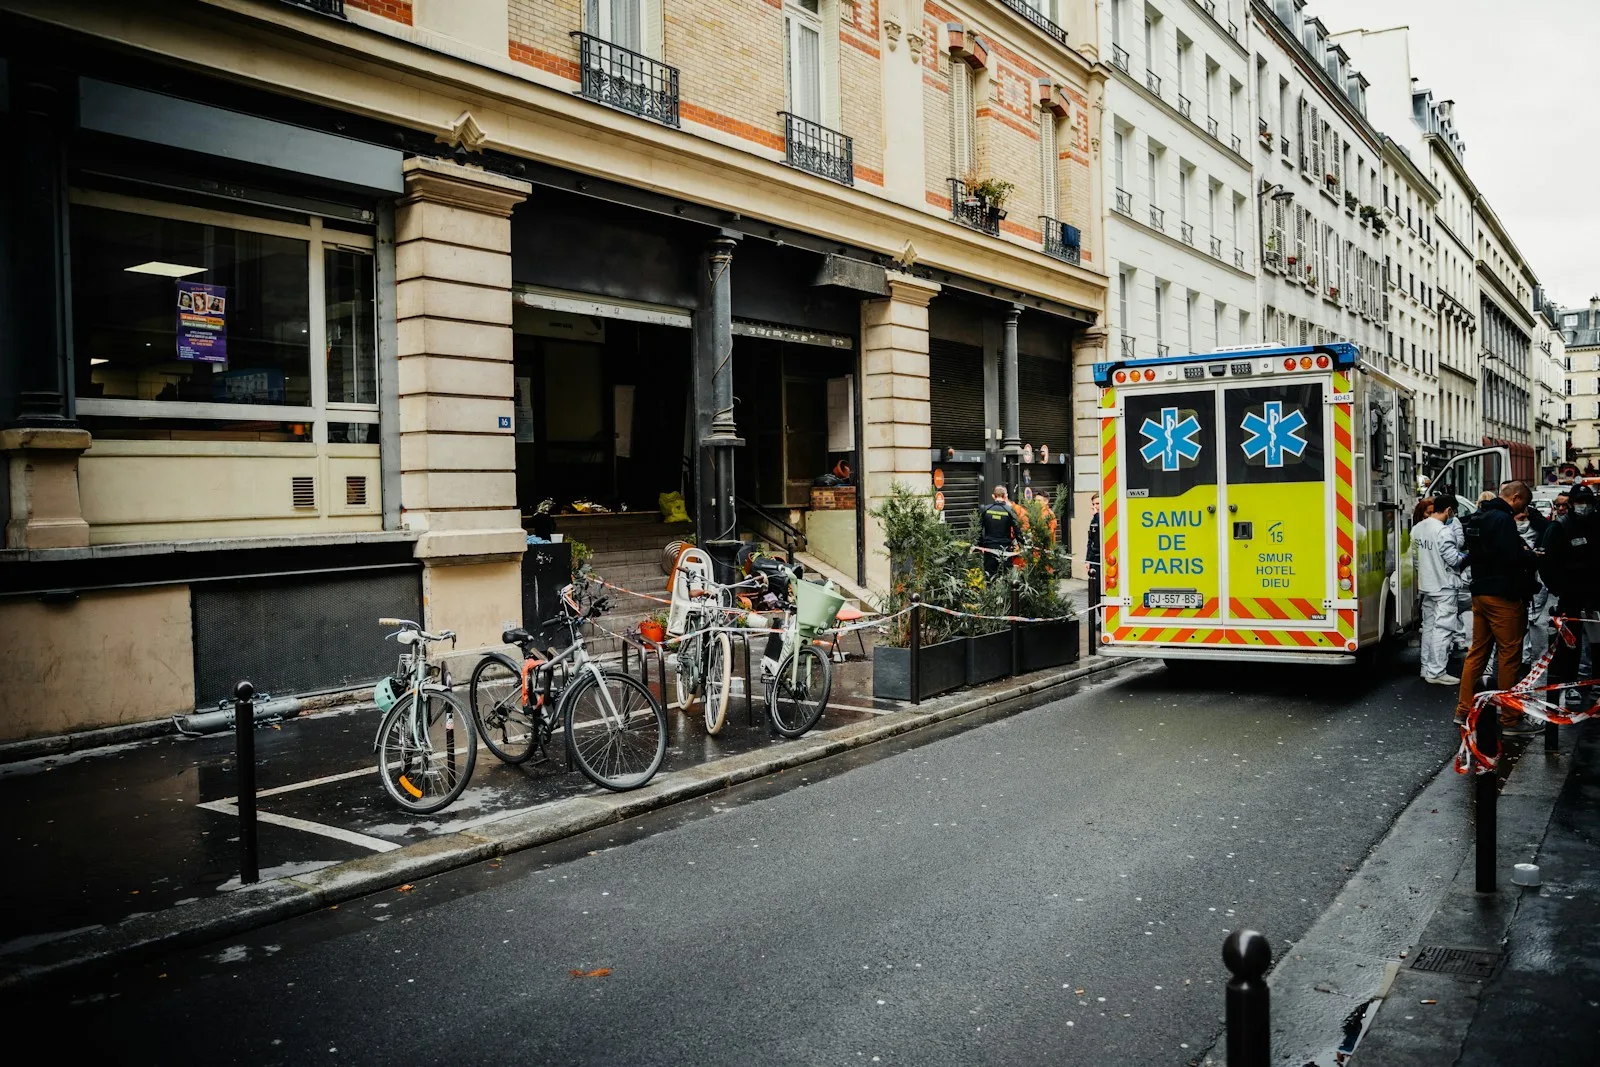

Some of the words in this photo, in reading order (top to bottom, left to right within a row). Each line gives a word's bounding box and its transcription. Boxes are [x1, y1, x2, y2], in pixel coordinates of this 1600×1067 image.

[501, 418, 509, 427] 16
[1141, 510, 1202, 528] SAMU
[1158, 534, 1186, 551] DE
[1270, 531, 1283, 543] 15
[1258, 553, 1293, 563] SMUR
[1141, 558, 1204, 575] PARIS
[1256, 565, 1296, 575] HOTEL
[1262, 578, 1290, 588] DIEU
[1150, 594, 1196, 605] GJ-557-BS
